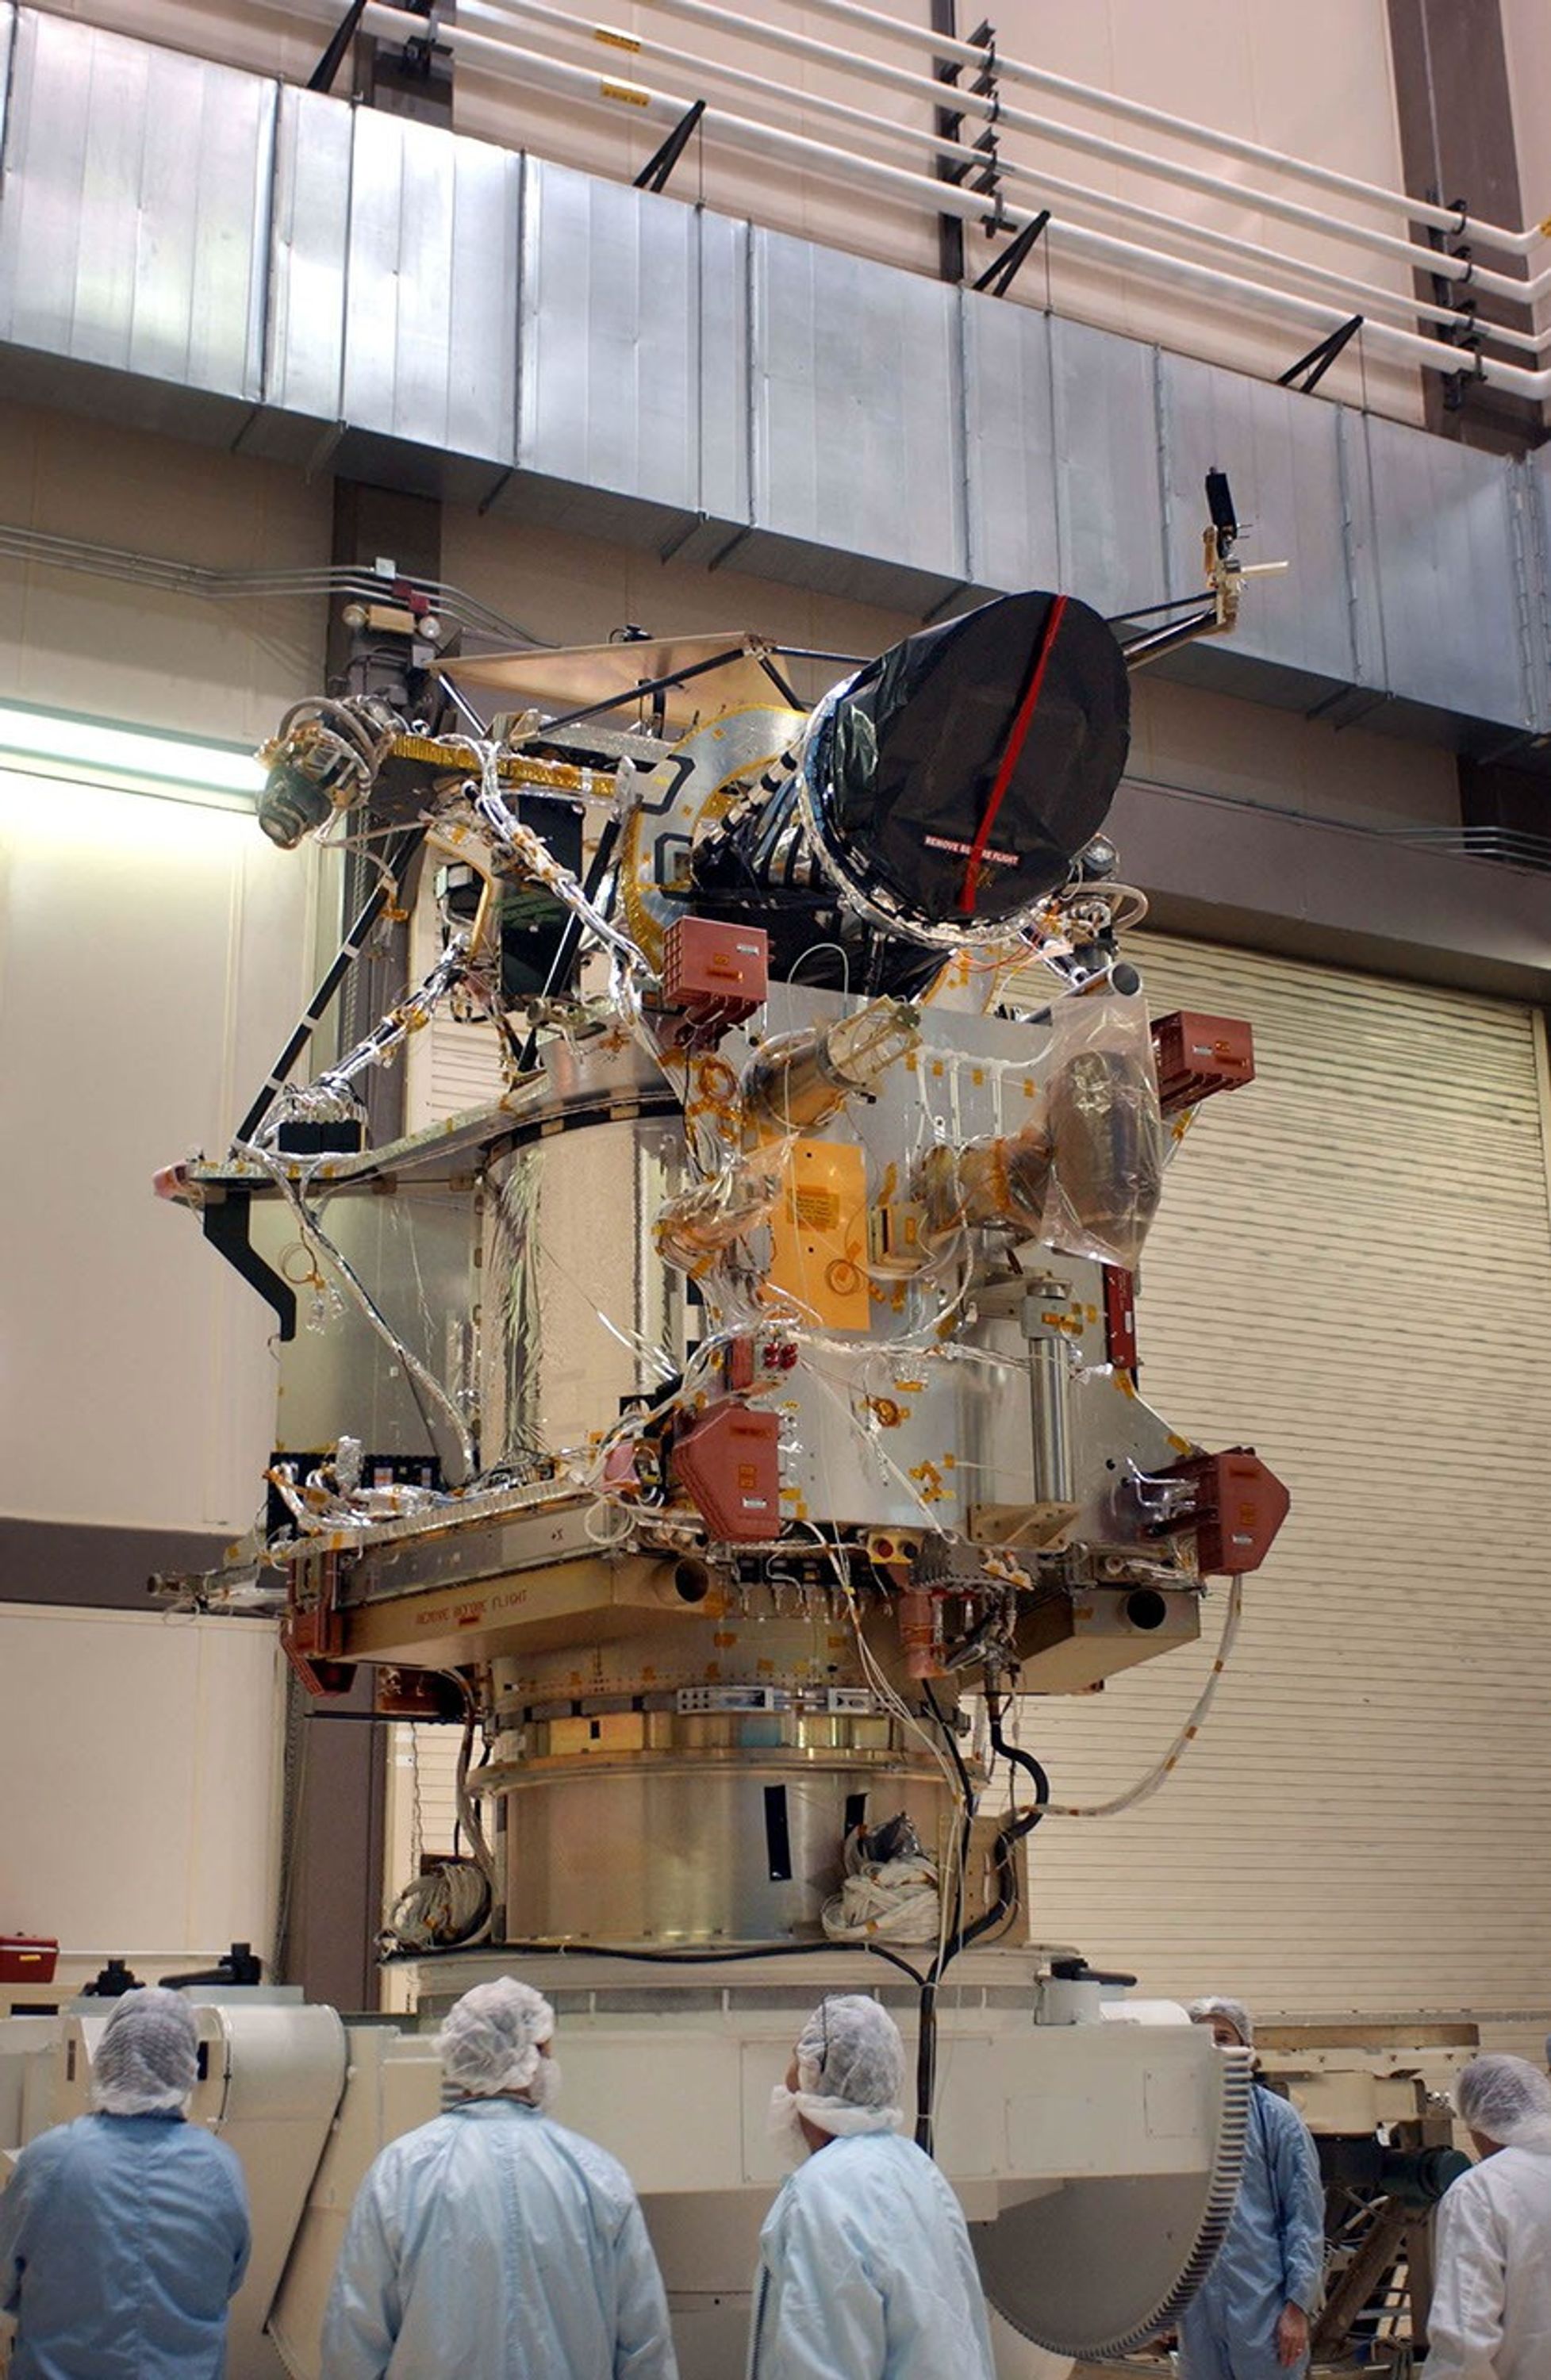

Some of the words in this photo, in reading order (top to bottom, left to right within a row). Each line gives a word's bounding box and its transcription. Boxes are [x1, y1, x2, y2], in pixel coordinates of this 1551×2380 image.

[924, 835, 960, 853] REMOVE
[959, 843, 992, 860] BERE
[991, 851, 1019, 866] FLIGHT
[492, 1589, 528, 1610] FLIGHT
